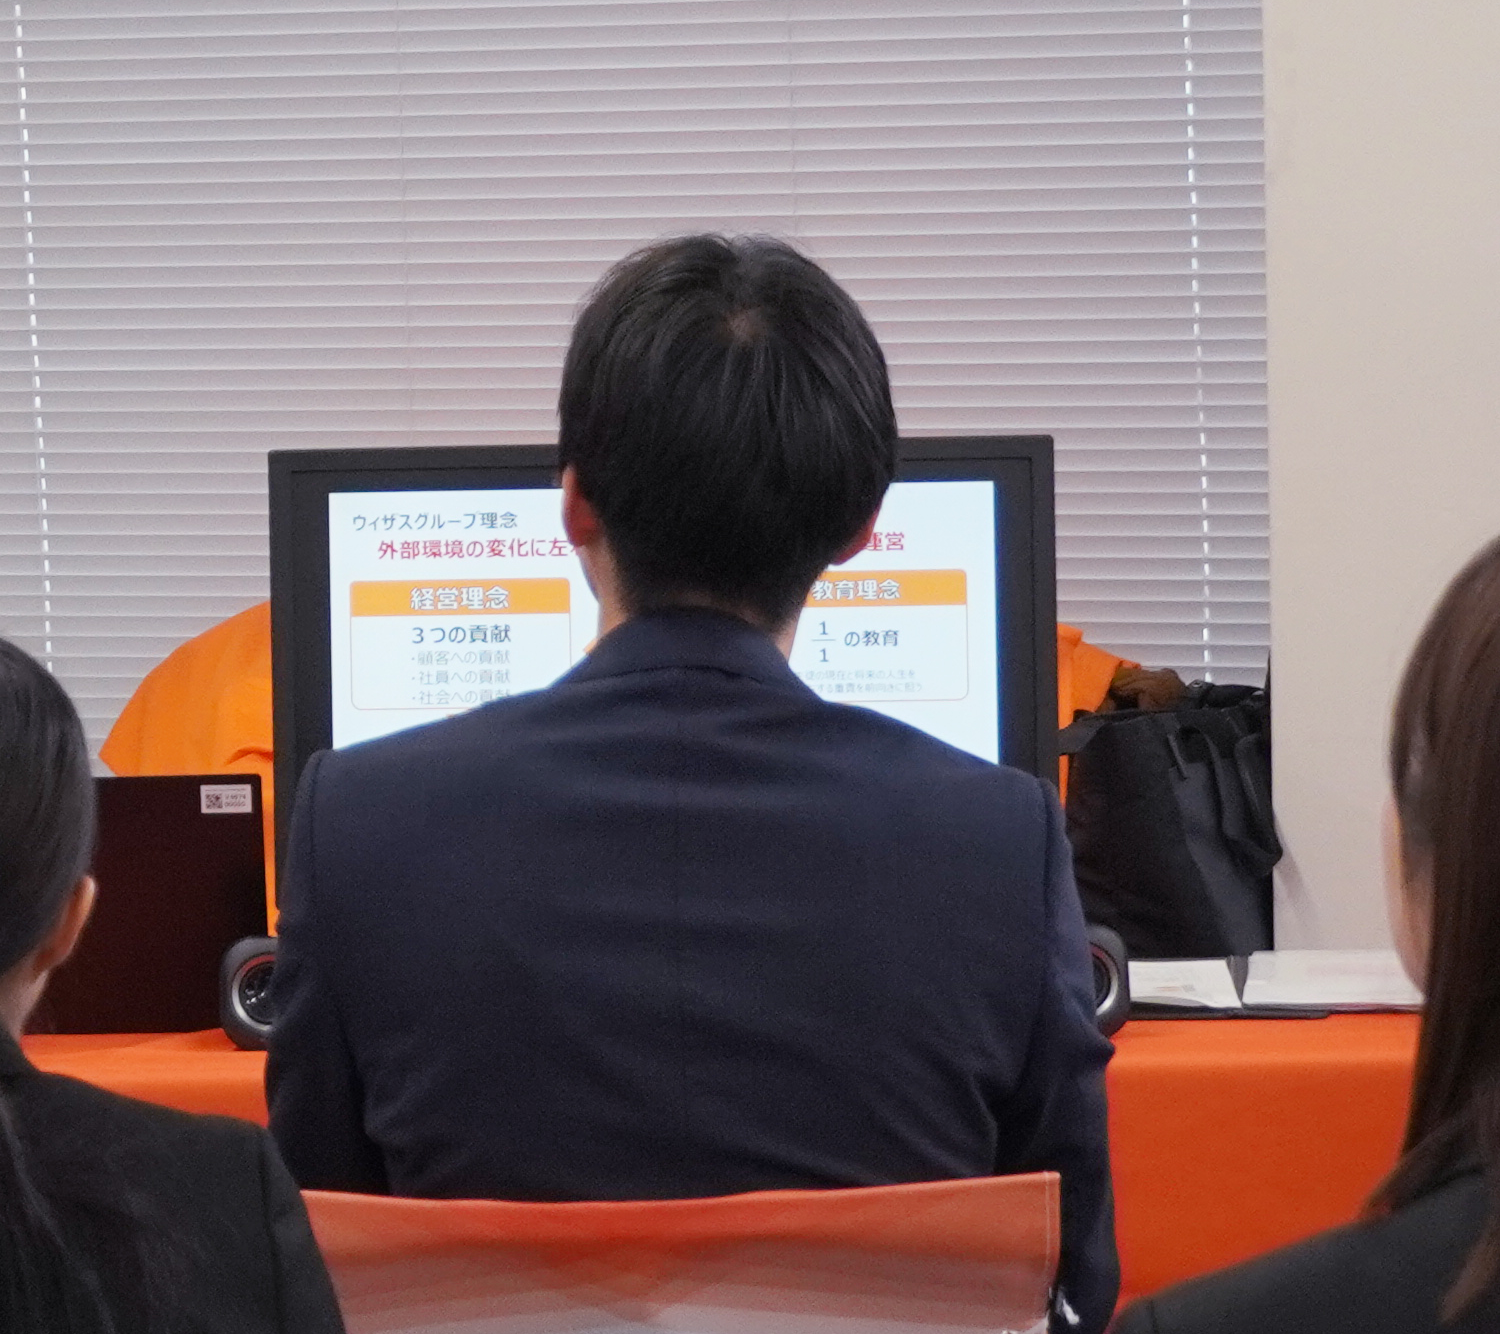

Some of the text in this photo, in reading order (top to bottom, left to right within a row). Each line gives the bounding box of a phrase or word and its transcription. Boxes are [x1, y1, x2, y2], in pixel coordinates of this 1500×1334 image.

[353, 512, 518, 531] ウィザスグループ理念
[410, 585, 509, 610] 経営理念
[813, 579, 900, 600] 教育理念
[412, 624, 511, 644] 3つの貢献
[844, 630, 899, 647] の教育
